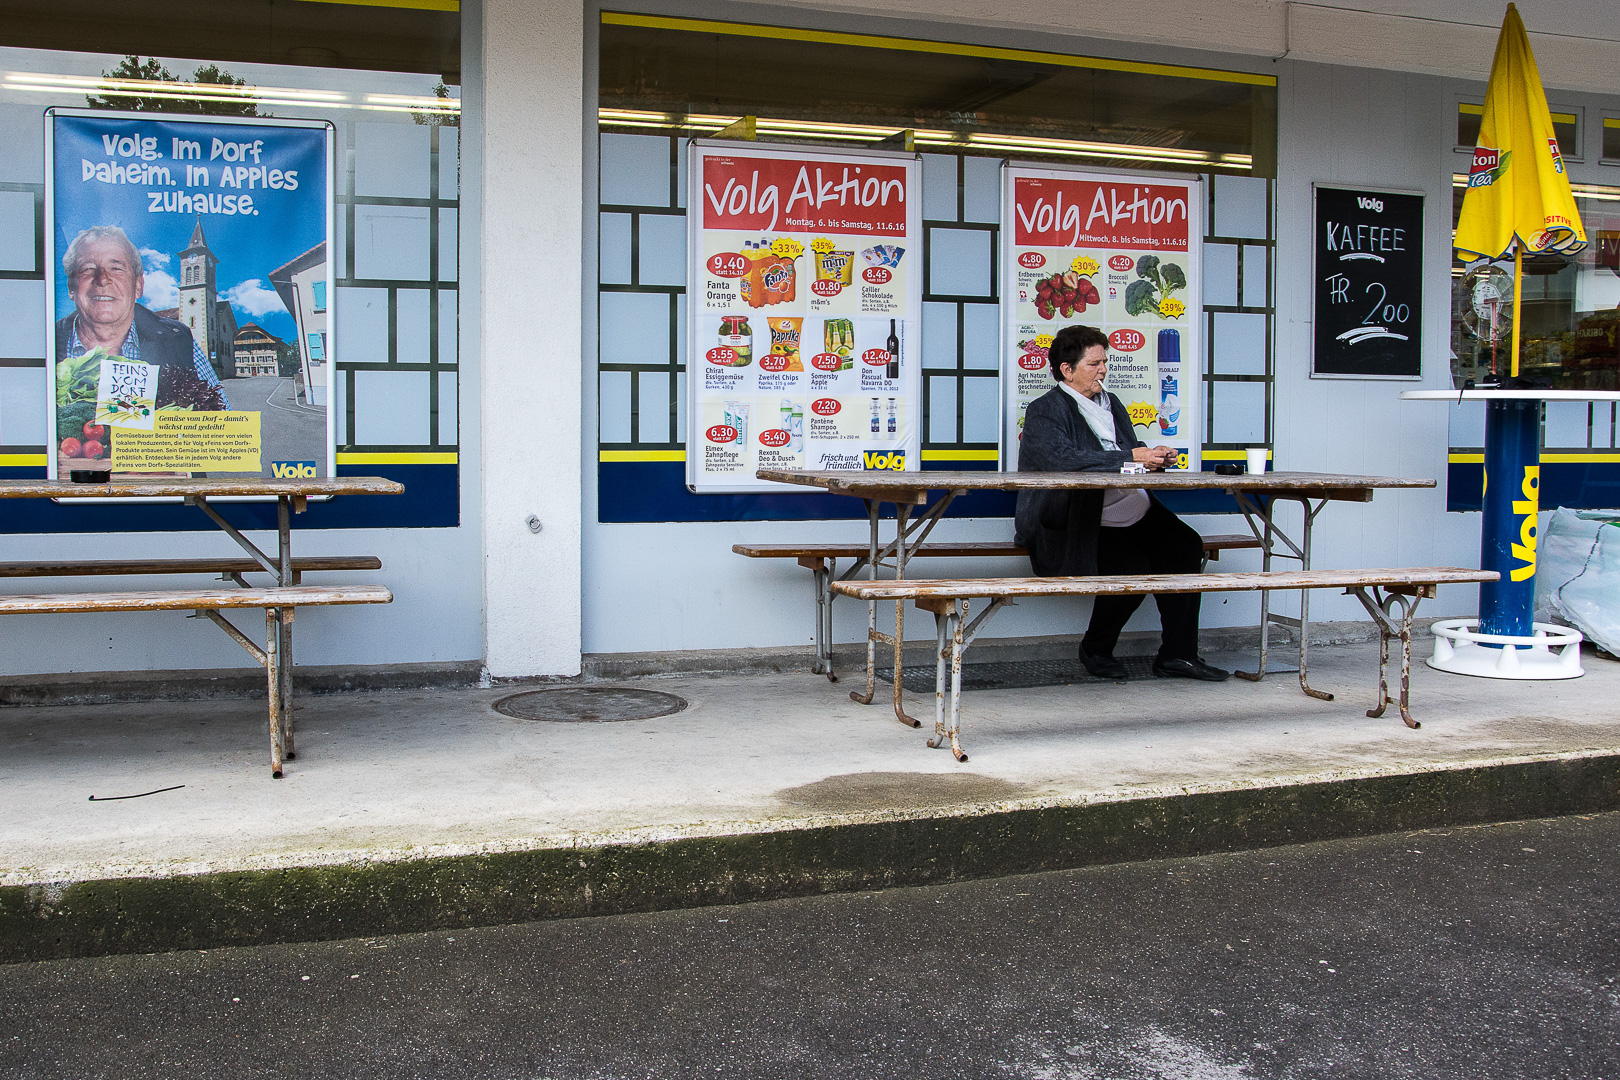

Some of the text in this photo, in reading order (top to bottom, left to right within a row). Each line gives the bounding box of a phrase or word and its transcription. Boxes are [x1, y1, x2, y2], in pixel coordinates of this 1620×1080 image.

[102, 133, 264, 164] Volg. Im Dorf
[82, 158, 176, 186] Daheim.
[186, 164, 210, 187] In
[1470, 173, 1492, 187] Tea
[148, 190, 259, 216] zuhause.
[705, 166, 904, 232] Volg Aktion
[1357, 197, 1383, 213] Volg
[1016, 186, 1187, 248] Volg Aktion
[785, 217, 905, 231] Montag, 6. bis Samstag, 11.6.16
[1079, 234, 1110, 244] Mittwoch,
[1120, 236, 1130, 244] bis
[1132, 237, 1160, 246] Samstag,
[1162, 238, 1187, 246] 11.6.16
[1327, 222, 1406, 251] KAFFEE
[714, 257, 745, 269] 9.40
[1023, 255, 1041, 263] 4.80
[1112, 258, 1130, 266] 4.20
[867, 269, 887, 278] 8.45
[707, 281, 730, 289] Fanta
[813, 282, 840, 290] 10.80
[707, 291, 736, 301] Orange
[771, 328, 800, 344] Paprika
[1115, 333, 1140, 344] 3.30
[711, 350, 733, 359] 3.55
[864, 352, 889, 360] 12.40
[1109, 355, 1133, 363] Floralp
[764, 357, 785, 365] 3.70
[817, 356, 837, 365] 7.50
[1023, 356, 1042, 364] 1.80
[110, 384, 146, 398] DORF
[817, 401, 836, 409] 7.20
[711, 428, 733, 436] 6.30
[764, 432, 785, 441] 5.40
[819, 454, 844, 463] frisch
[864, 452, 905, 471] Volg
[825, 462, 861, 471] fründlich
